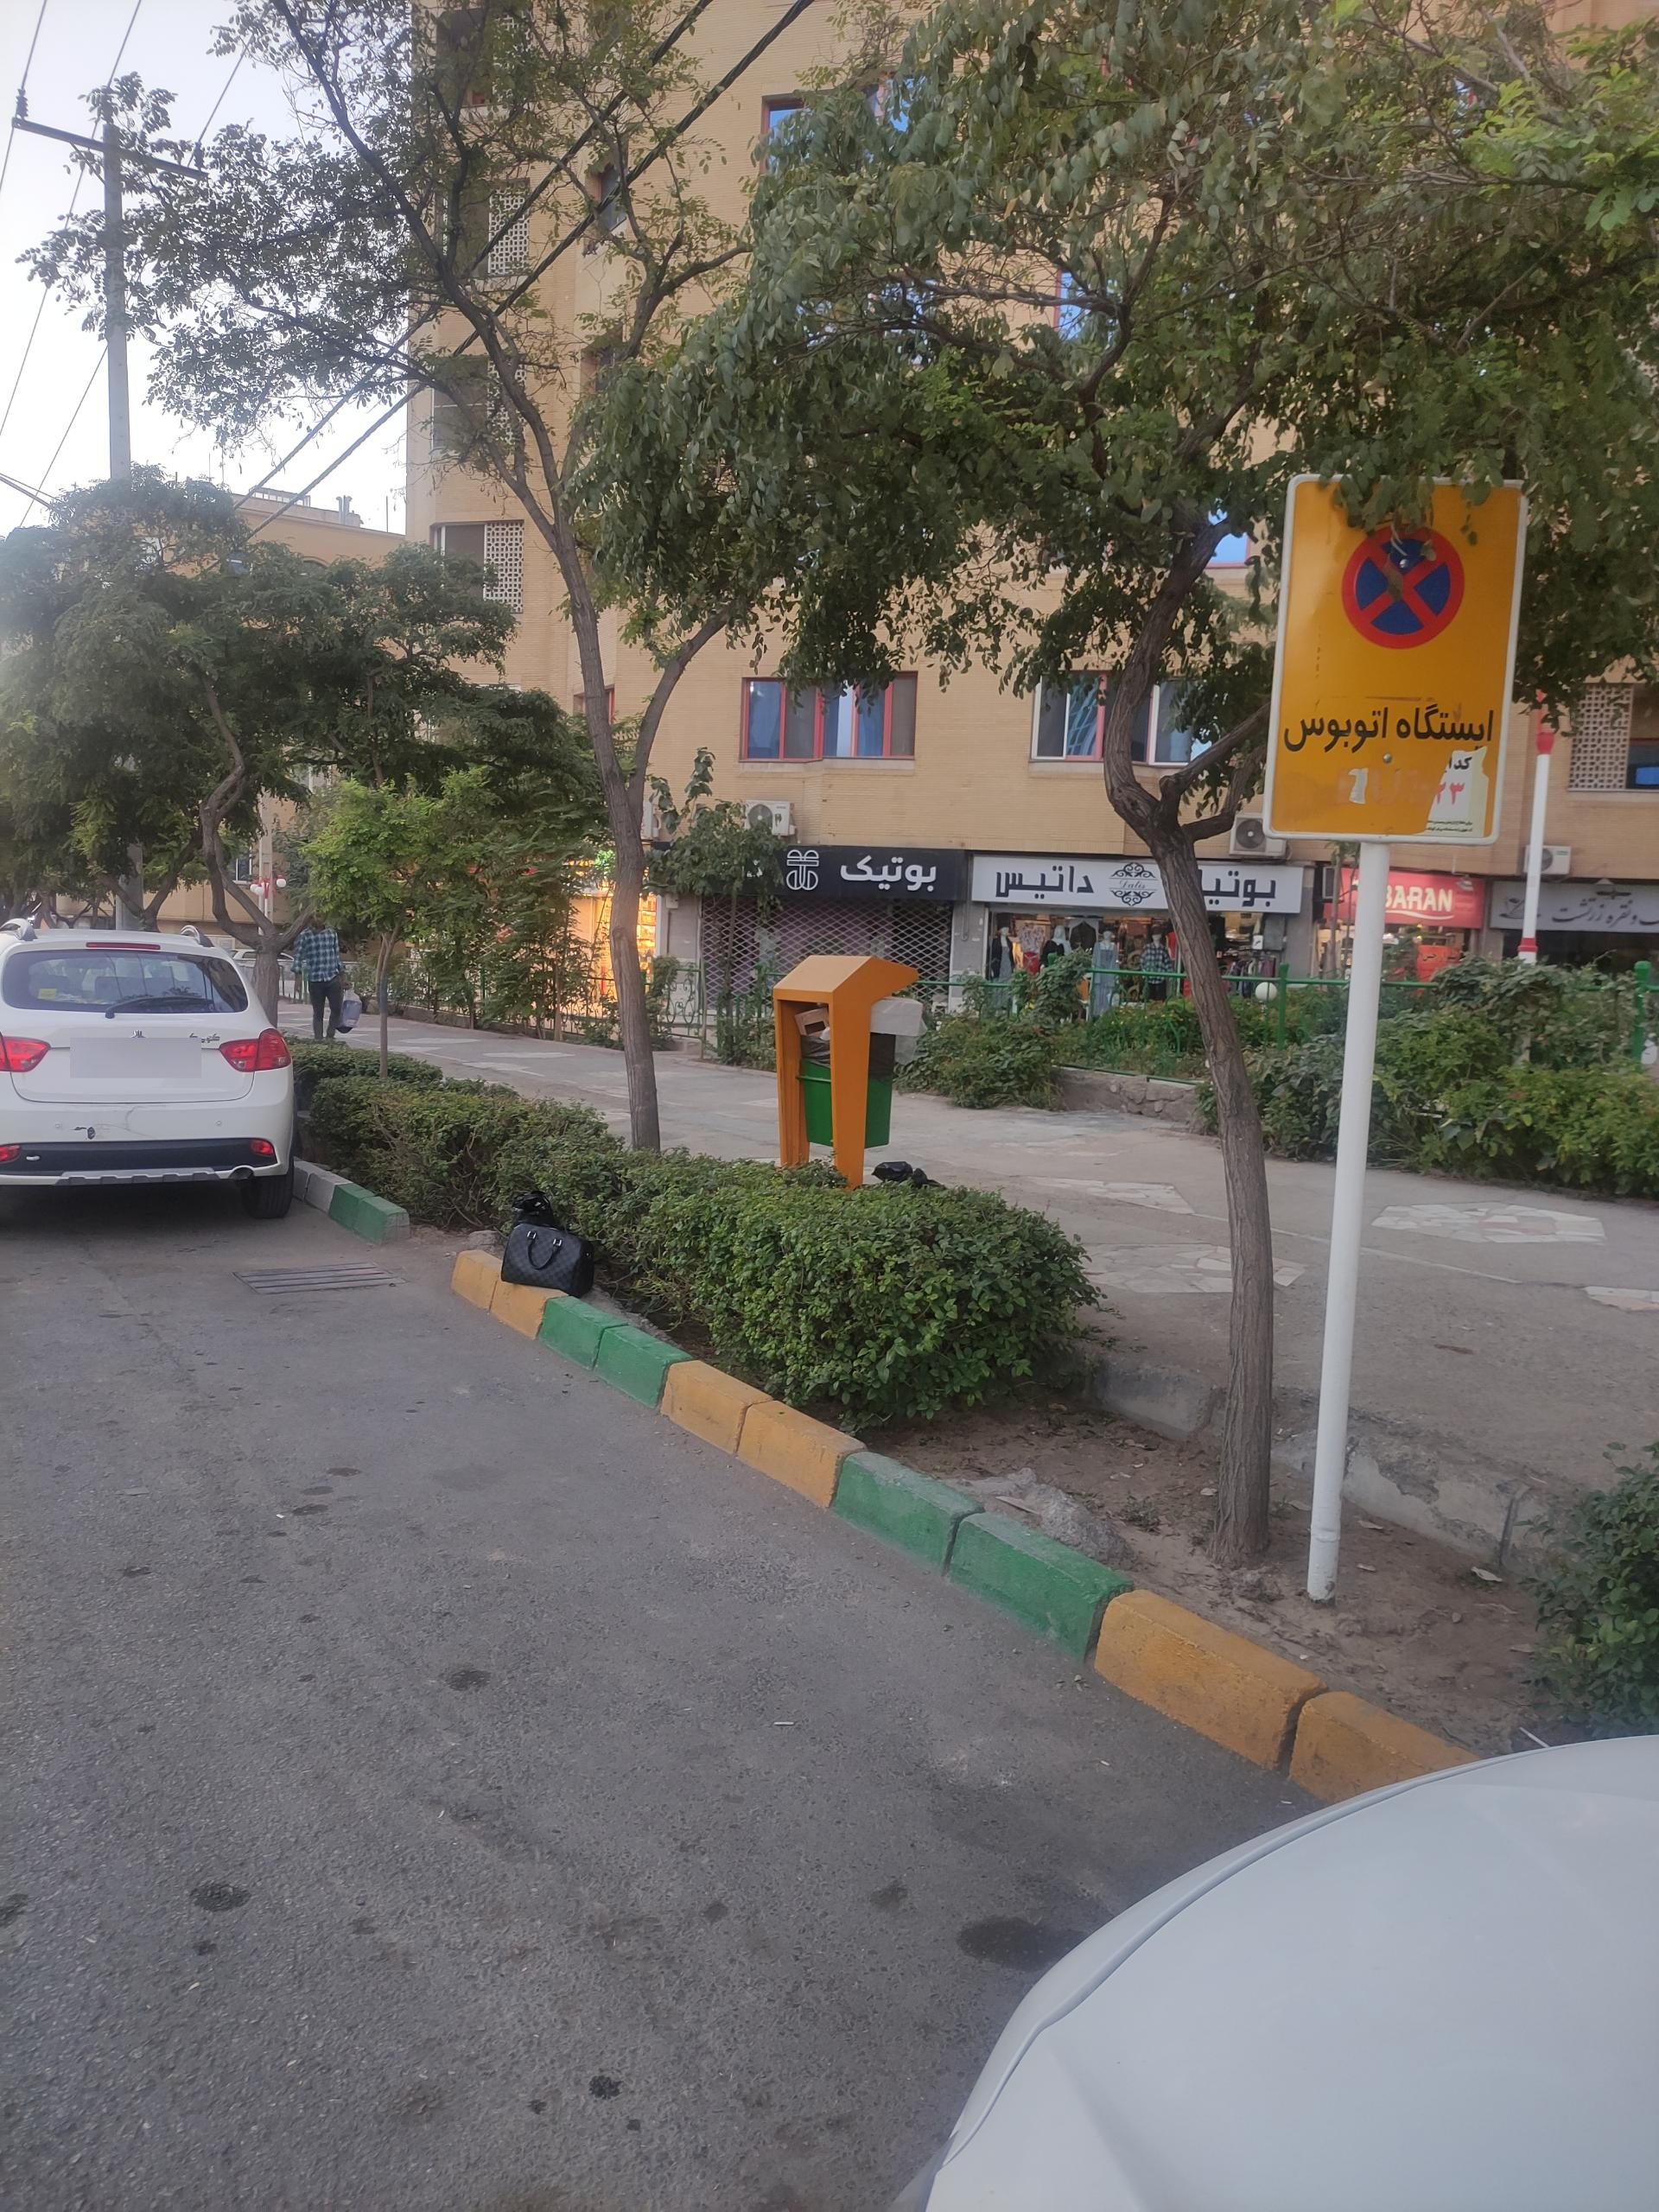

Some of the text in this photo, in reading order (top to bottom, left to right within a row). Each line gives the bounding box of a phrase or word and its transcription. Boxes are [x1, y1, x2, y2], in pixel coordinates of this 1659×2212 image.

[1284, 703, 1494, 753] ایستگاه اتوبوس
[840, 855, 937, 892] بوتیک
[995, 865, 1276, 907] بوتی داتیس
